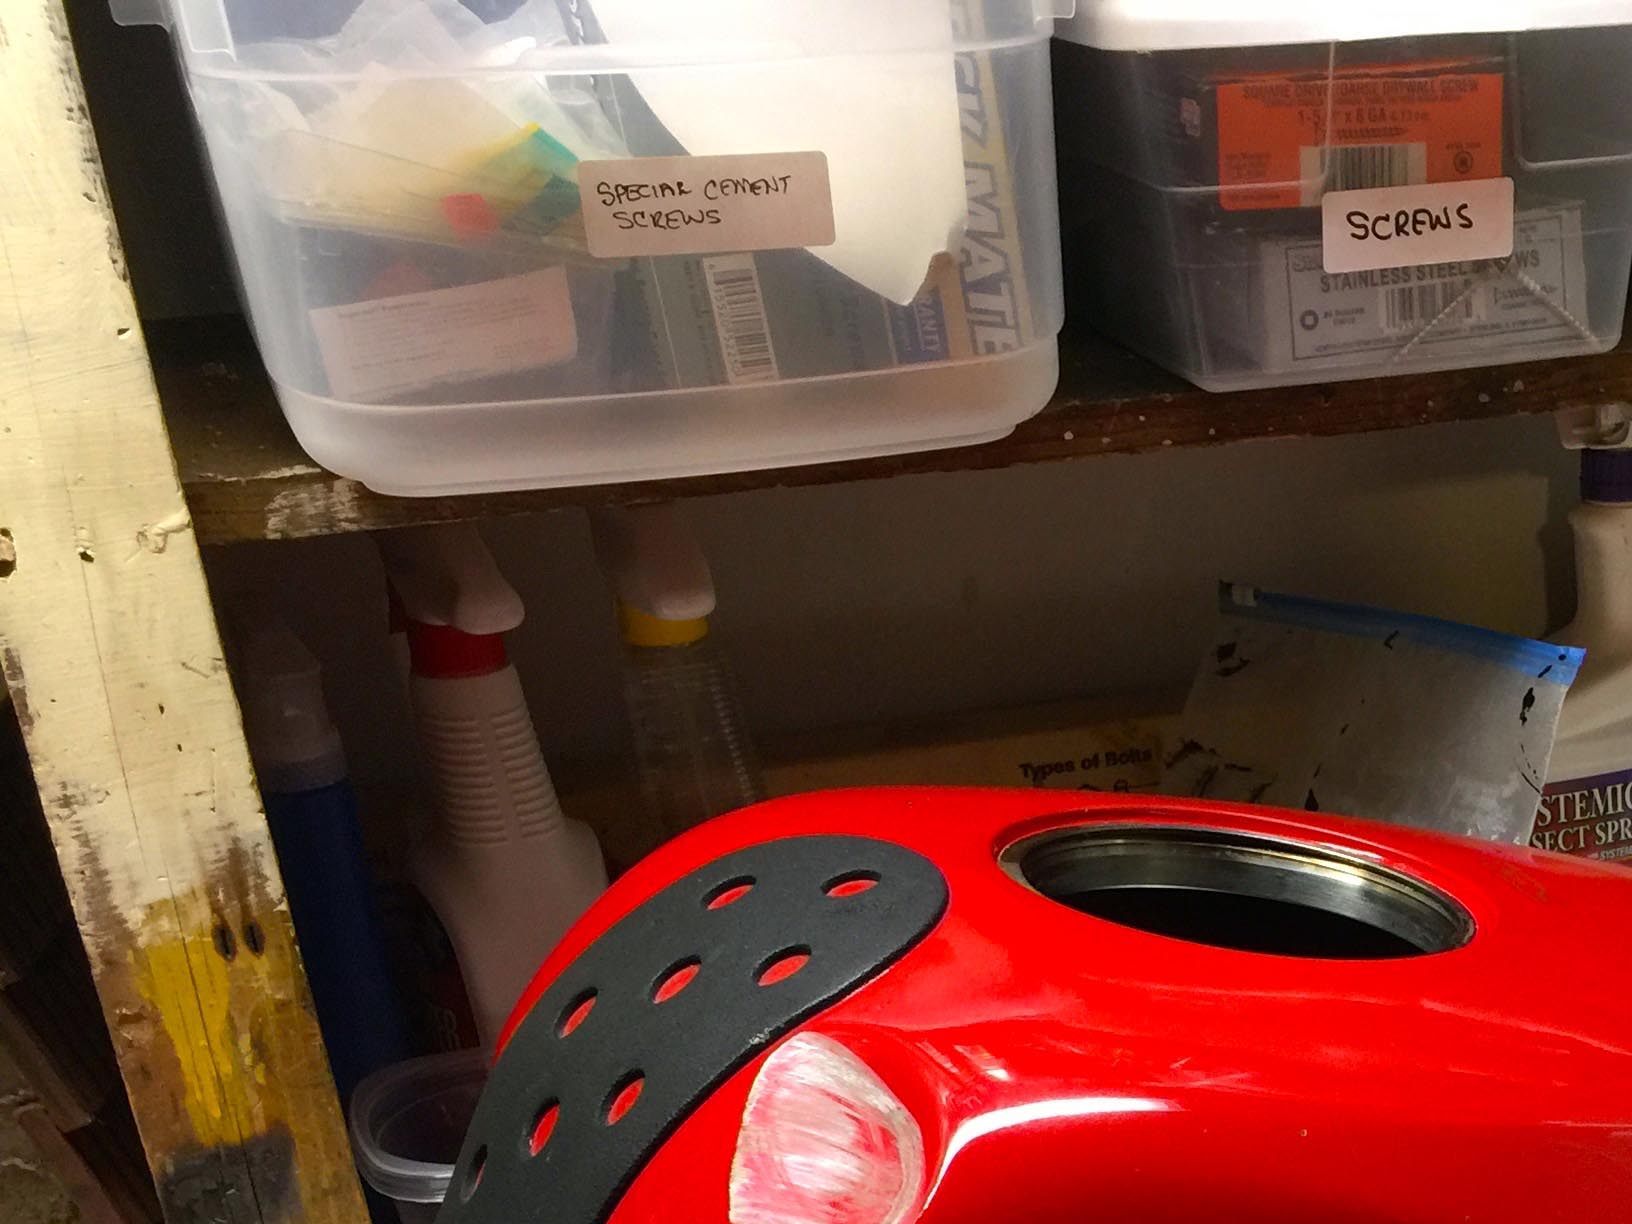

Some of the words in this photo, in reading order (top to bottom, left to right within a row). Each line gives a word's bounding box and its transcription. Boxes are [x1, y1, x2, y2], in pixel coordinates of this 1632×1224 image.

[704, 175, 791, 200] CEMENT
[612, 209, 722, 231] SCREWS
[1345, 203, 1473, 241] SCREWS
[1320, 264, 1411, 293] STAINLESS
[1416, 259, 1460, 281] STEEL
[1018, 759, 1076, 783] Types
[1081, 753, 1100, 771] of
[1105, 748, 1152, 767] Bolts
